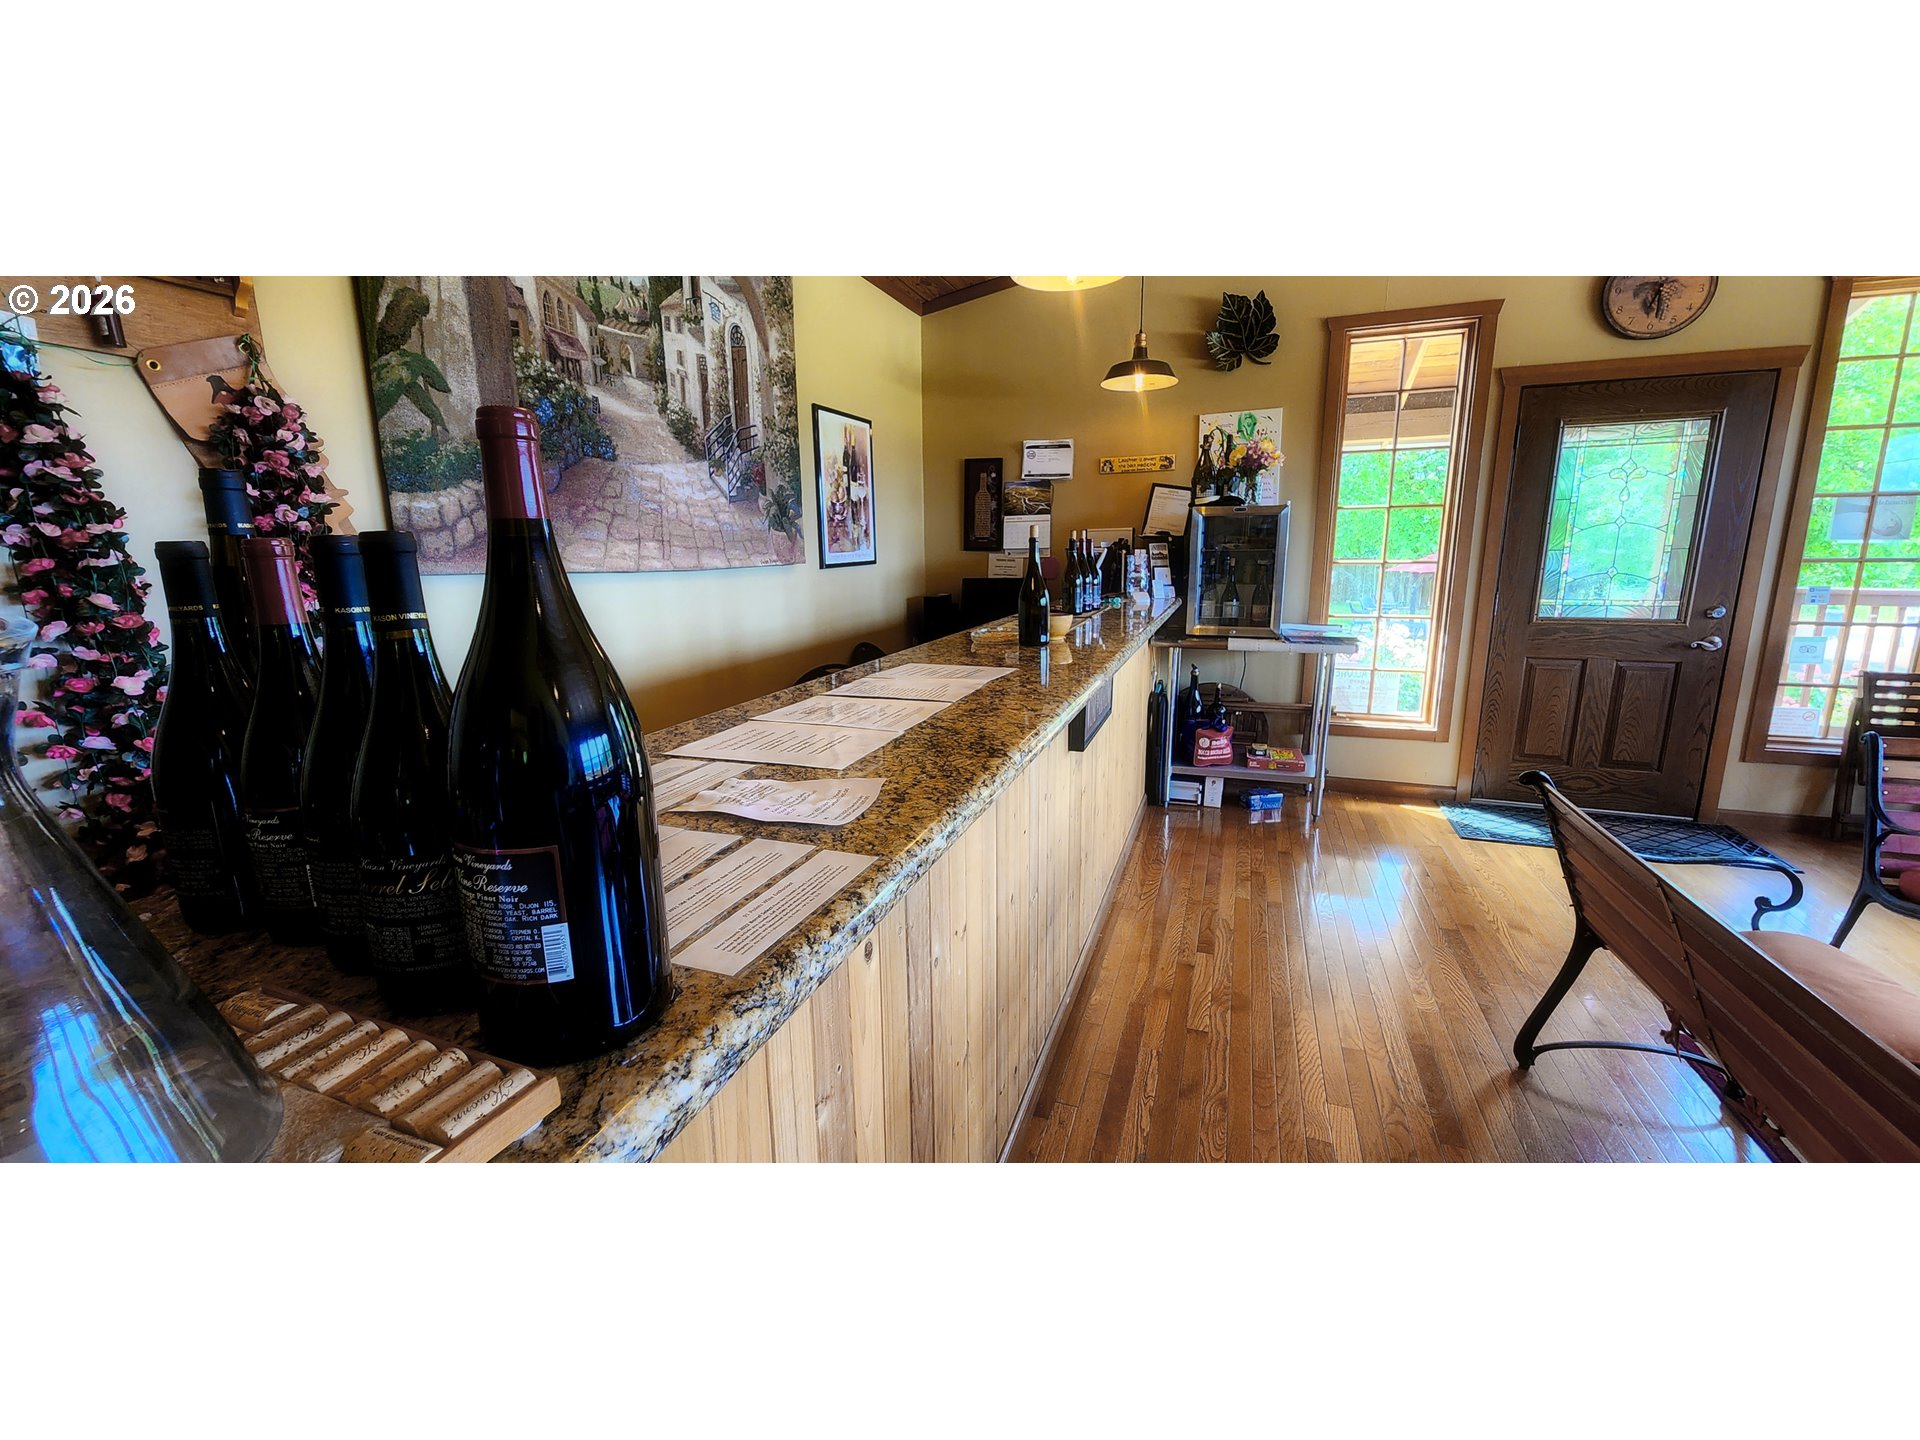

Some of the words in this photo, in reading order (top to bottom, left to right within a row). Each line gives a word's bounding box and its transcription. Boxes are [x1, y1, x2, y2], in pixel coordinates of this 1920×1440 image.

[1614, 287, 1622, 297] 9
[1698, 284, 1705, 293] 3
[1616, 305, 1624, 314] 8
[1685, 303, 1693, 312] 4
[1627, 316, 1635, 326] 7
[1669, 315, 1678, 324] 5
[1646, 322, 1654, 330] 6
[463, 853, 513, 874] Vineyards
[473, 874, 529, 893] Reserve
[476, 893, 497, 902] Pinot
[498, 895, 519, 903] Noir
